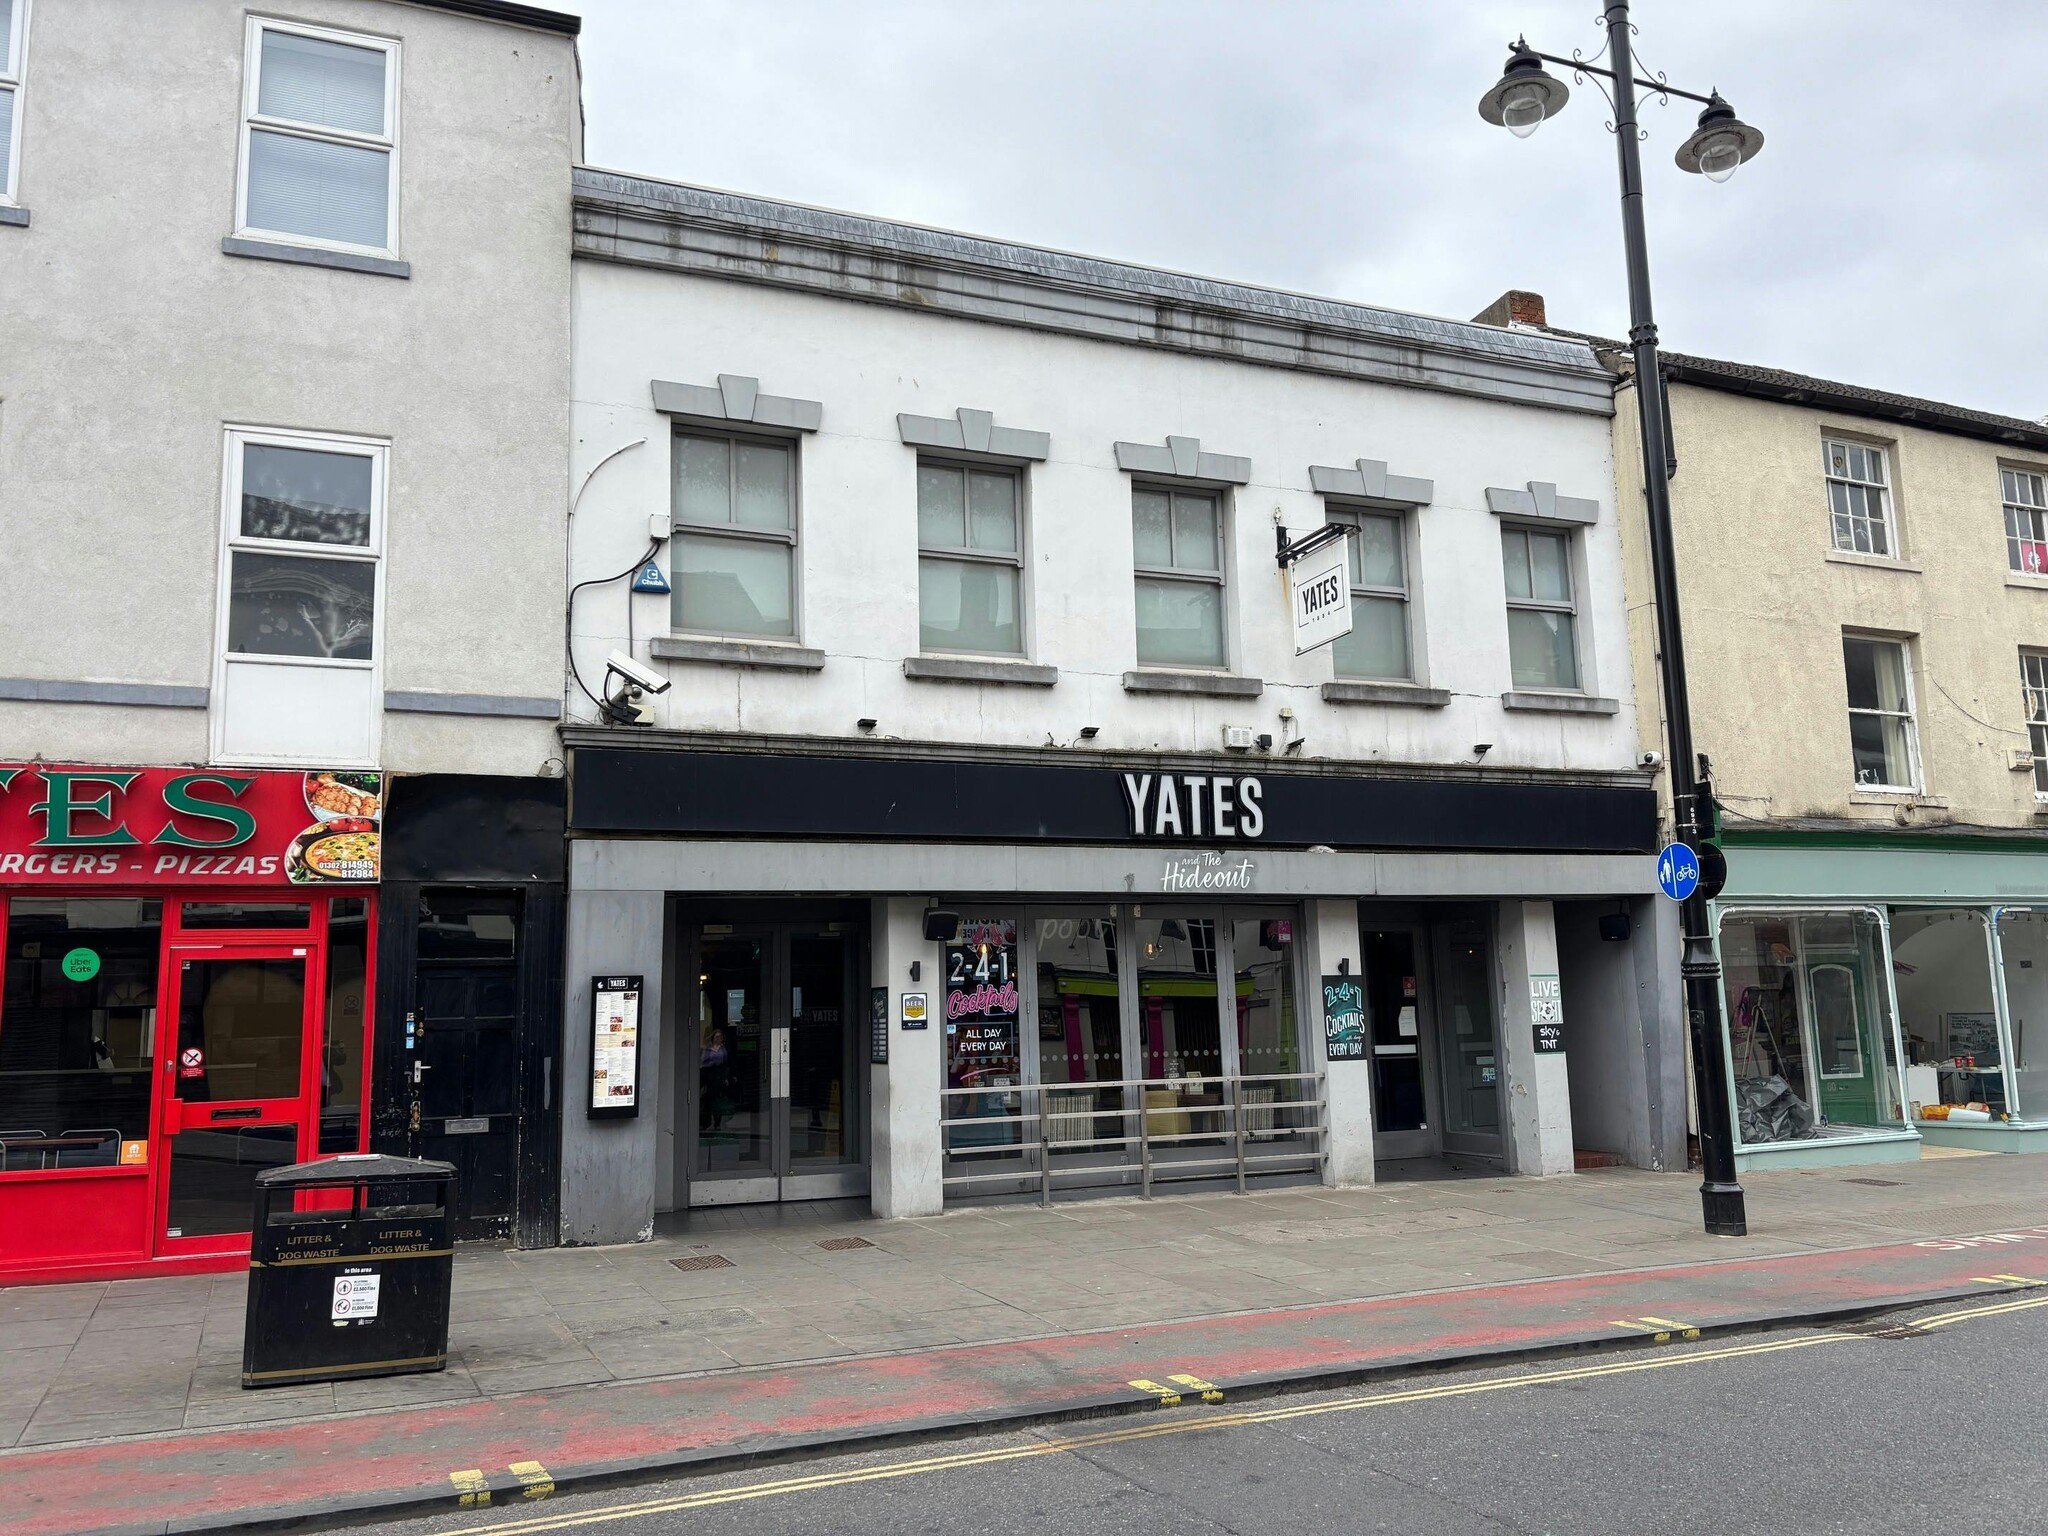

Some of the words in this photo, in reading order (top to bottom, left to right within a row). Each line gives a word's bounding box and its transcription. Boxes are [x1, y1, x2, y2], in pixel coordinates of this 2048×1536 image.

[1302, 574, 1338, 615] YATES
[1123, 773, 1264, 838] YATES
[0, 853, 120, 874] RGERS
[154, 854, 279, 875] PIZZAS
[341, 860, 374, 869] 814949
[1182, 855, 1200, 865] and
[1202, 852, 1222, 866] The
[341, 869, 374, 878] 812984
[1160, 858, 1254, 892] Hideout
[70, 965, 92, 973] Eats
[950, 952, 1008, 983] 2-4-1
[1530, 980, 1559, 998] LIVE
[947, 981, 1019, 1020] Cocktails
[812, 1009, 839, 1022] YATES
[1325, 1012, 1365, 1037] COCKTAILS
[965, 1029, 982, 1039] ALL
[984, 1028, 1002, 1038] DAY
[1540, 1025, 1556, 1039] sky
[960, 1041, 988, 1052] EVERY
[989, 1040, 1007, 1051] DAY
[1329, 1043, 1348, 1056] EVERY
[1349, 1042, 1363, 1055] DAY
[1540, 1039, 1558, 1049] TNT
[287, 1235, 323, 1245] LITTER
[324, 1234, 332, 1243] &
[379, 1230, 413, 1239] LITTER
[414, 1229, 422, 1237] &
[277, 1251, 302, 1260] DOG
[303, 1248, 340, 1259] WASTE
[370, 1245, 392, 1254] DOG
[393, 1243, 430, 1253] WASTE
